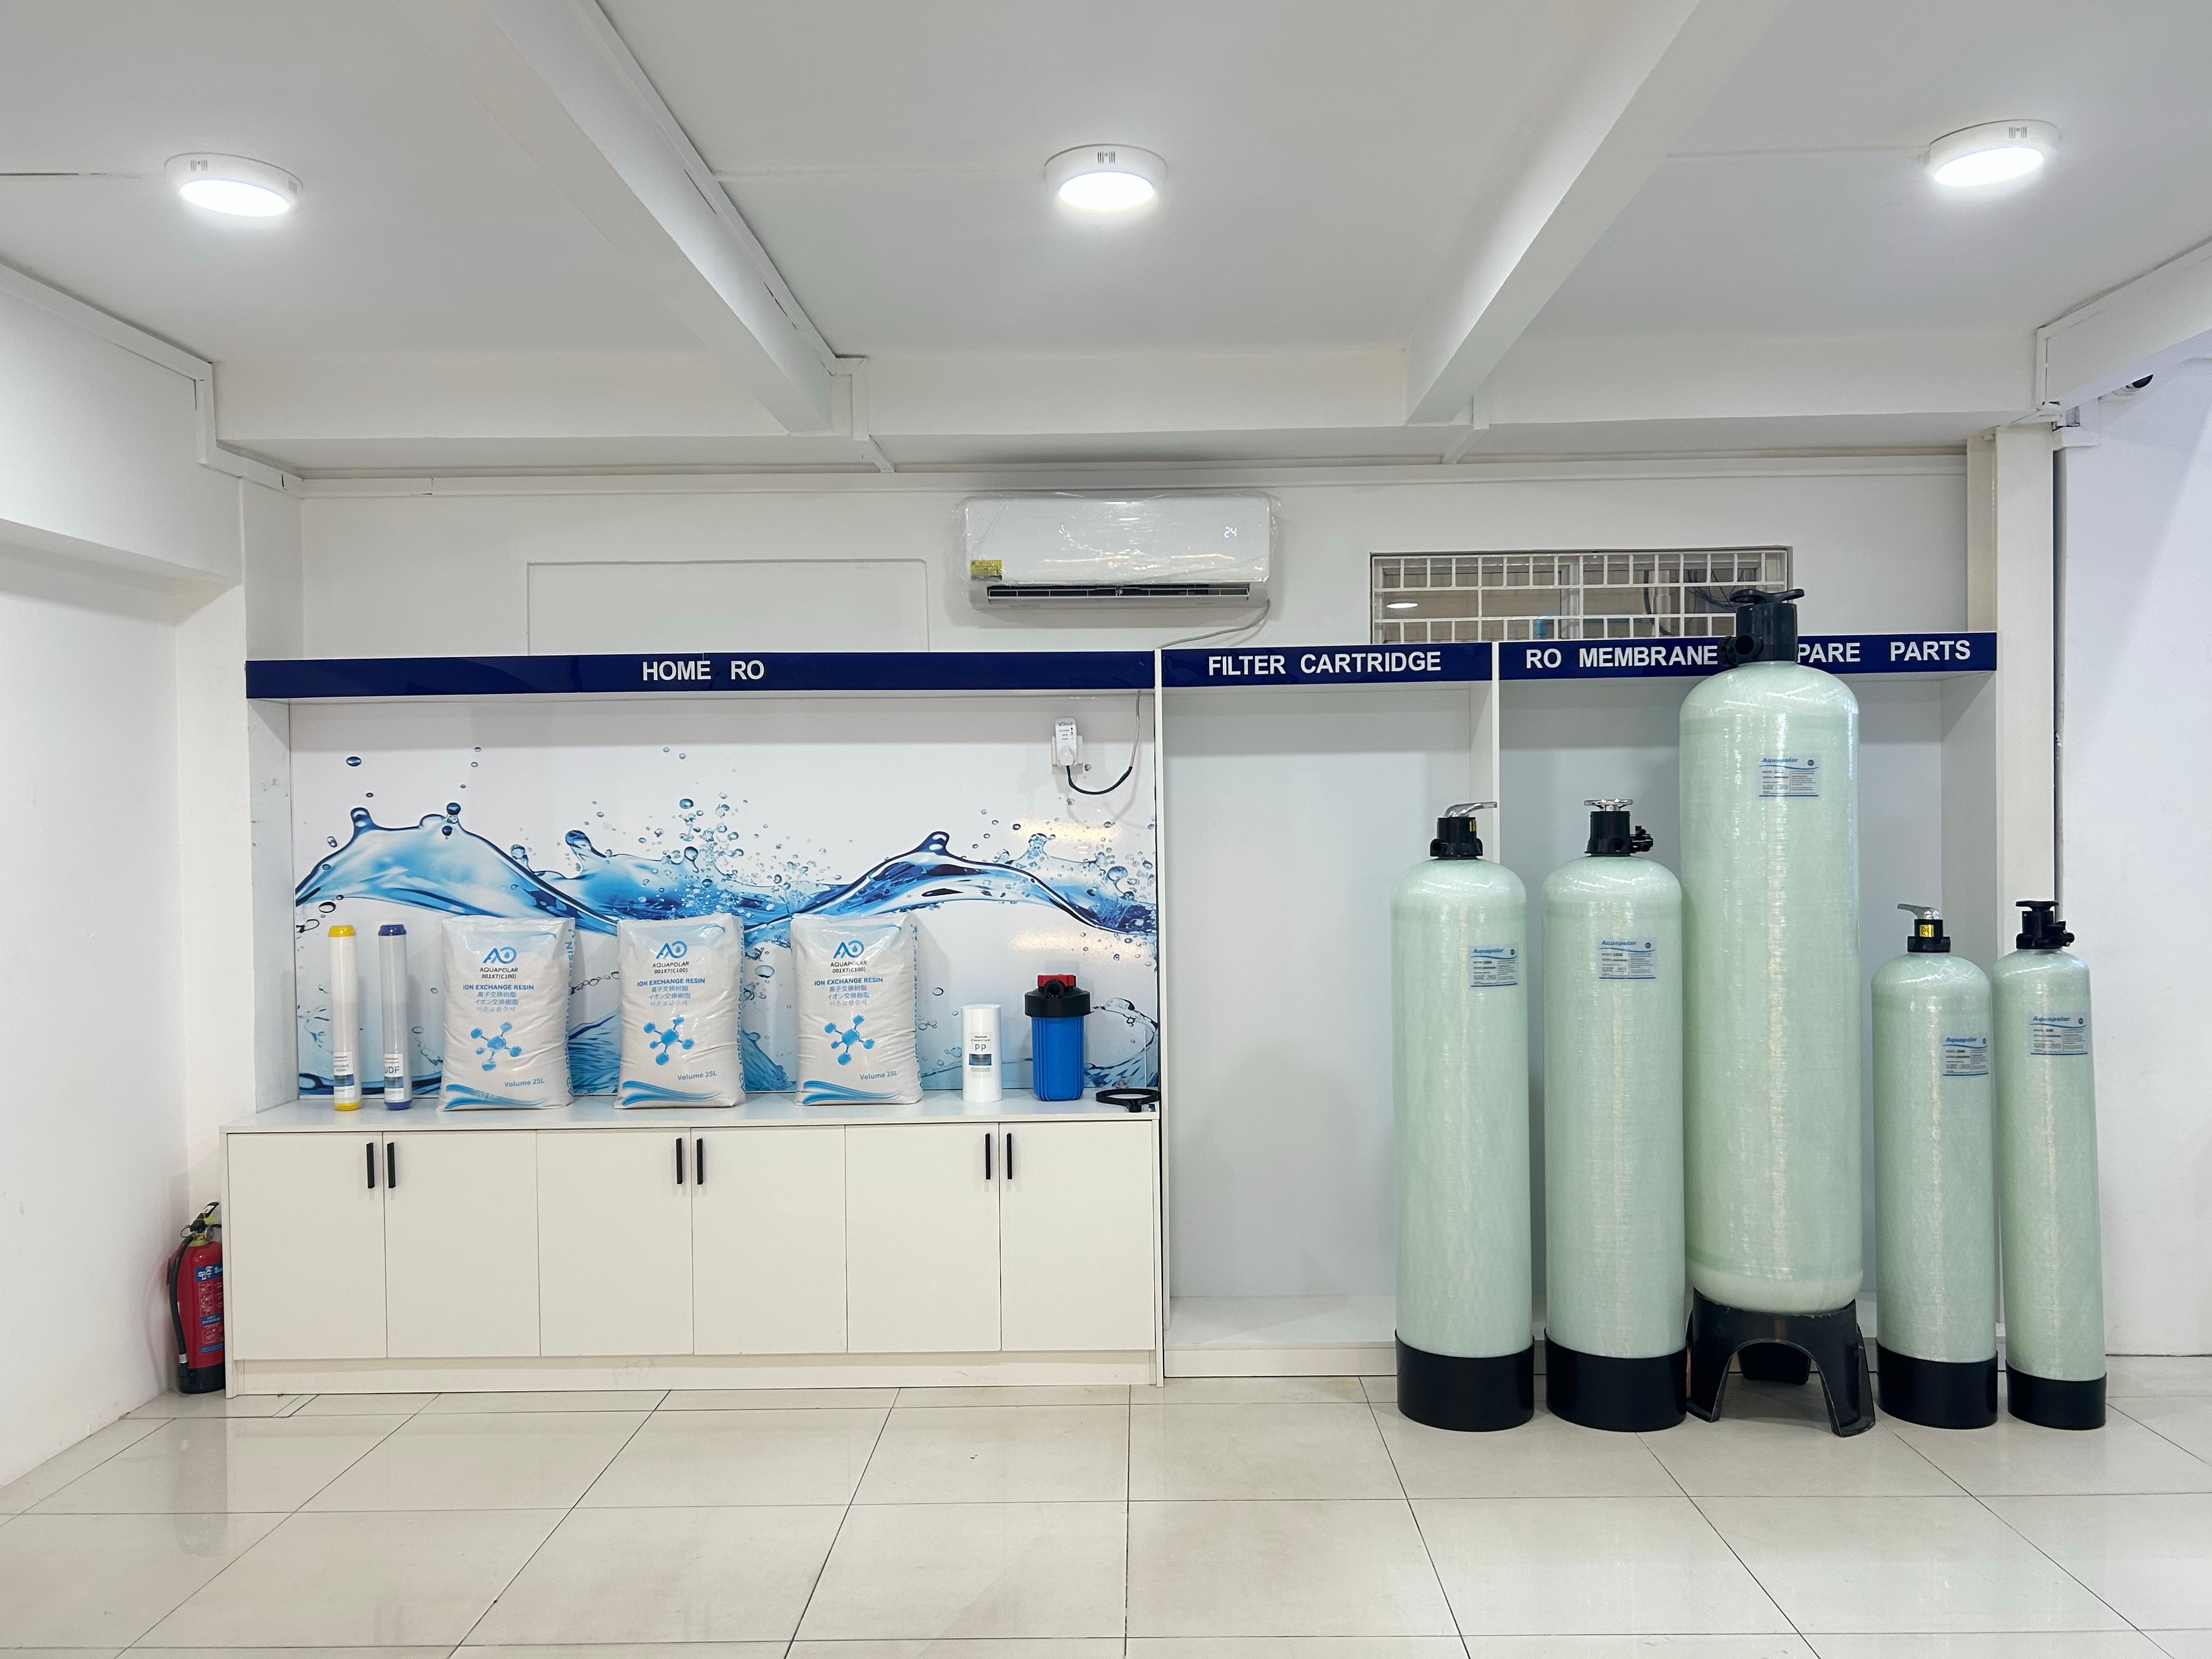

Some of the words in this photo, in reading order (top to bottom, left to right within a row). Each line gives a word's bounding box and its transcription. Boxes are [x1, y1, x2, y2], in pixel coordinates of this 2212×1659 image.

[1224, 527, 1237, 538] 24
[1209, 656, 1286, 675] FILTER
[1301, 652, 1441, 673] CARTRIDGE
[1527, 649, 1562, 668] RO
[1580, 646, 1718, 667] MEMBRANE
[1797, 643, 1861, 663] PARE
[1891, 640, 1970, 661] PARTS
[643, 661, 711, 680] HOME
[732, 660, 764, 679] RO
[975, 1044, 986, 1052] PP
